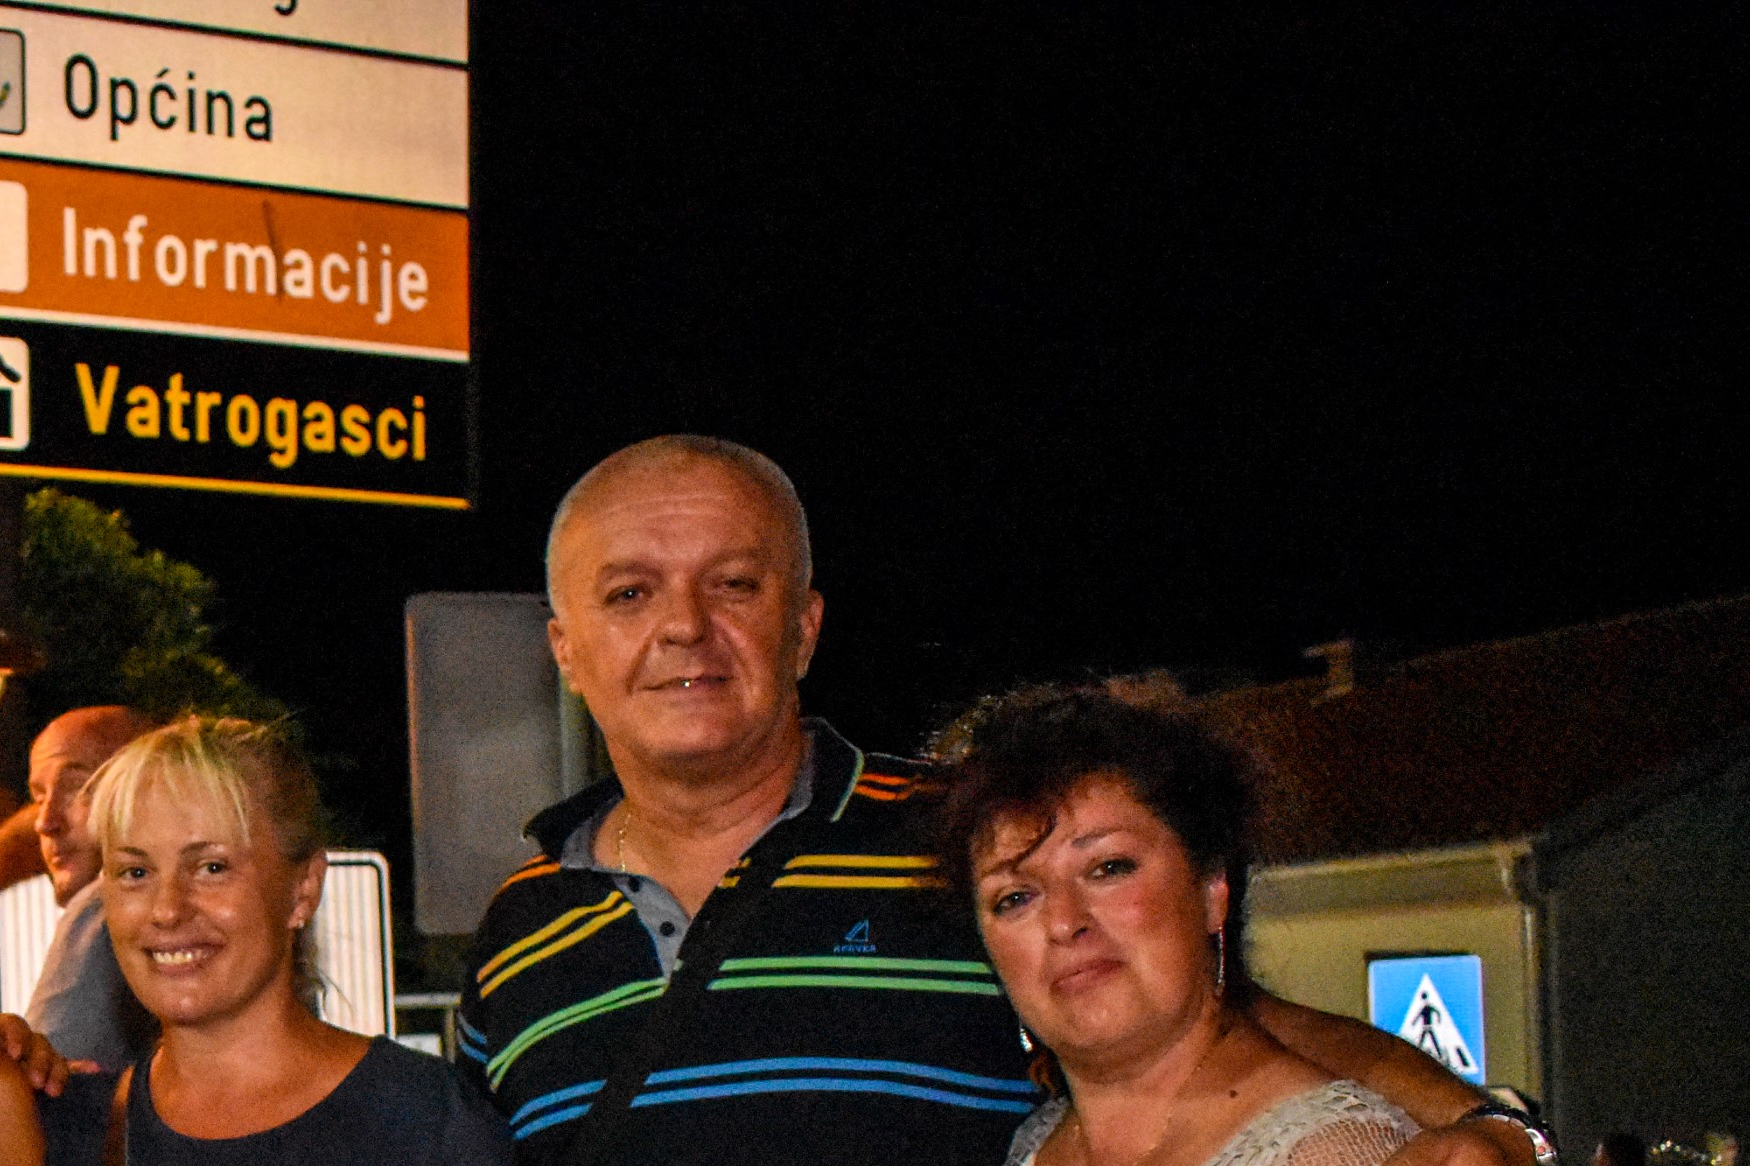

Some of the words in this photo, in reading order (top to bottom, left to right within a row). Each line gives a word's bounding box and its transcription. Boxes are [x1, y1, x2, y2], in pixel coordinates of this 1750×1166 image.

[65, 54, 273, 142] Općina
[63, 207, 429, 325] Informacije
[75, 362, 427, 469] Vatrogasci
